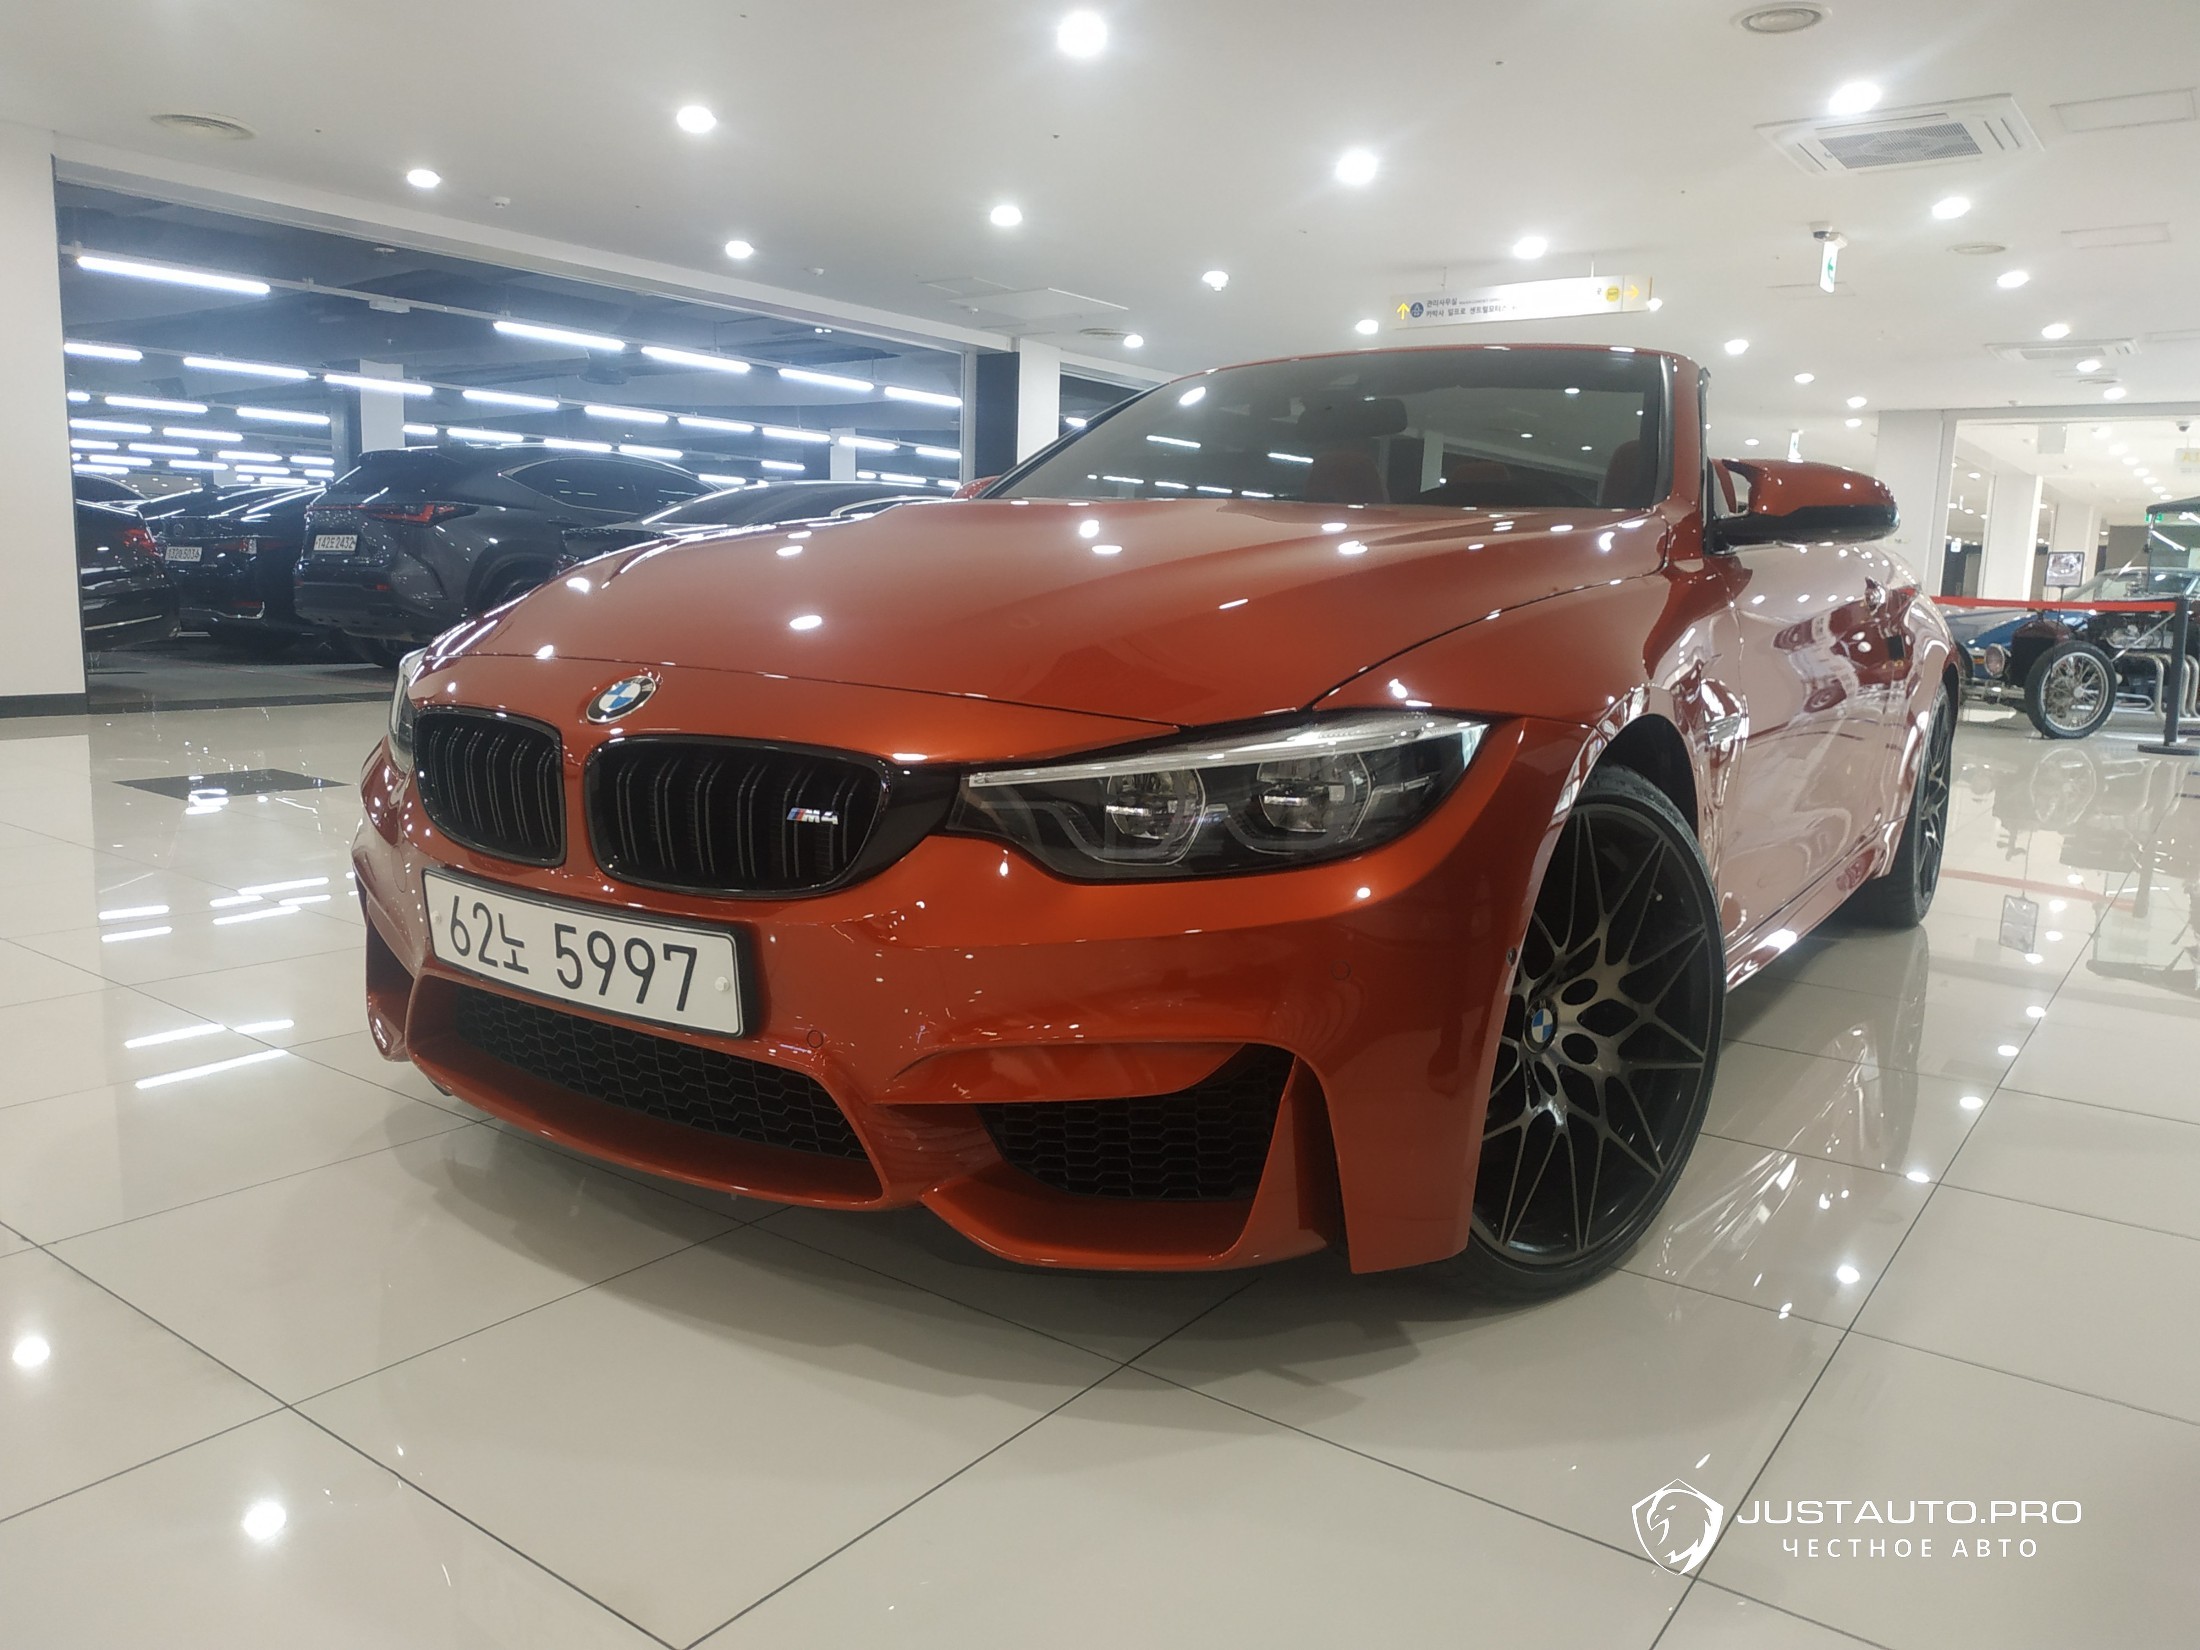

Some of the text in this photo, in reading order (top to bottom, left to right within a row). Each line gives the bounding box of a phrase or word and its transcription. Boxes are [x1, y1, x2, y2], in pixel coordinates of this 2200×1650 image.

[801, 808, 839, 825] M4
[449, 895, 698, 1012] 62노 5997
